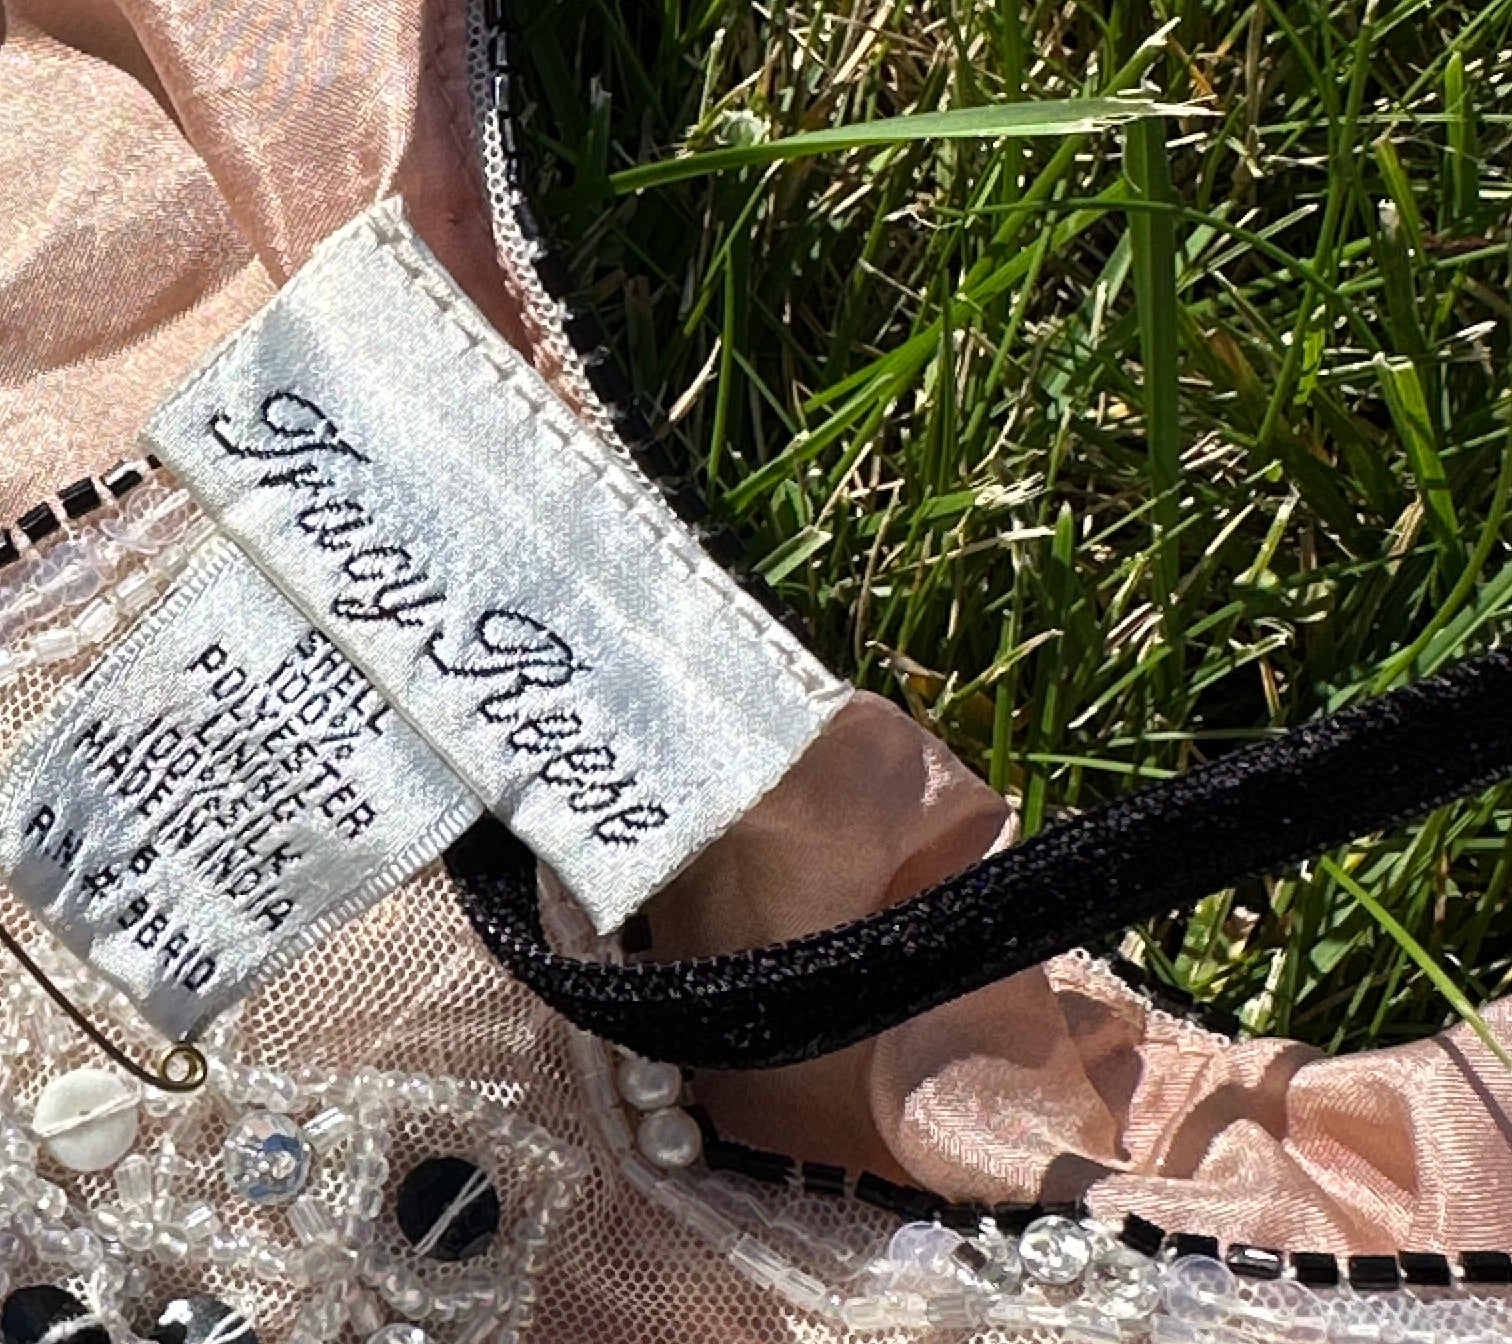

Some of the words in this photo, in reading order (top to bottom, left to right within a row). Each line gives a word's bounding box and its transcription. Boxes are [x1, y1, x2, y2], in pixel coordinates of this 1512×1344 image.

[210, 391, 446, 626] Tracy
[427, 609, 668, 845] Reese
[265, 659, 362, 761] 100%
[296, 631, 393, 736] SHELL
[190, 644, 378, 840] POLYESTER
[196, 711, 305, 825] LINING
[74, 723, 173, 815] MADE
[158, 796, 205, 850] IN
[199, 838, 295, 932] INDIA
[128, 841, 160, 876] 6
